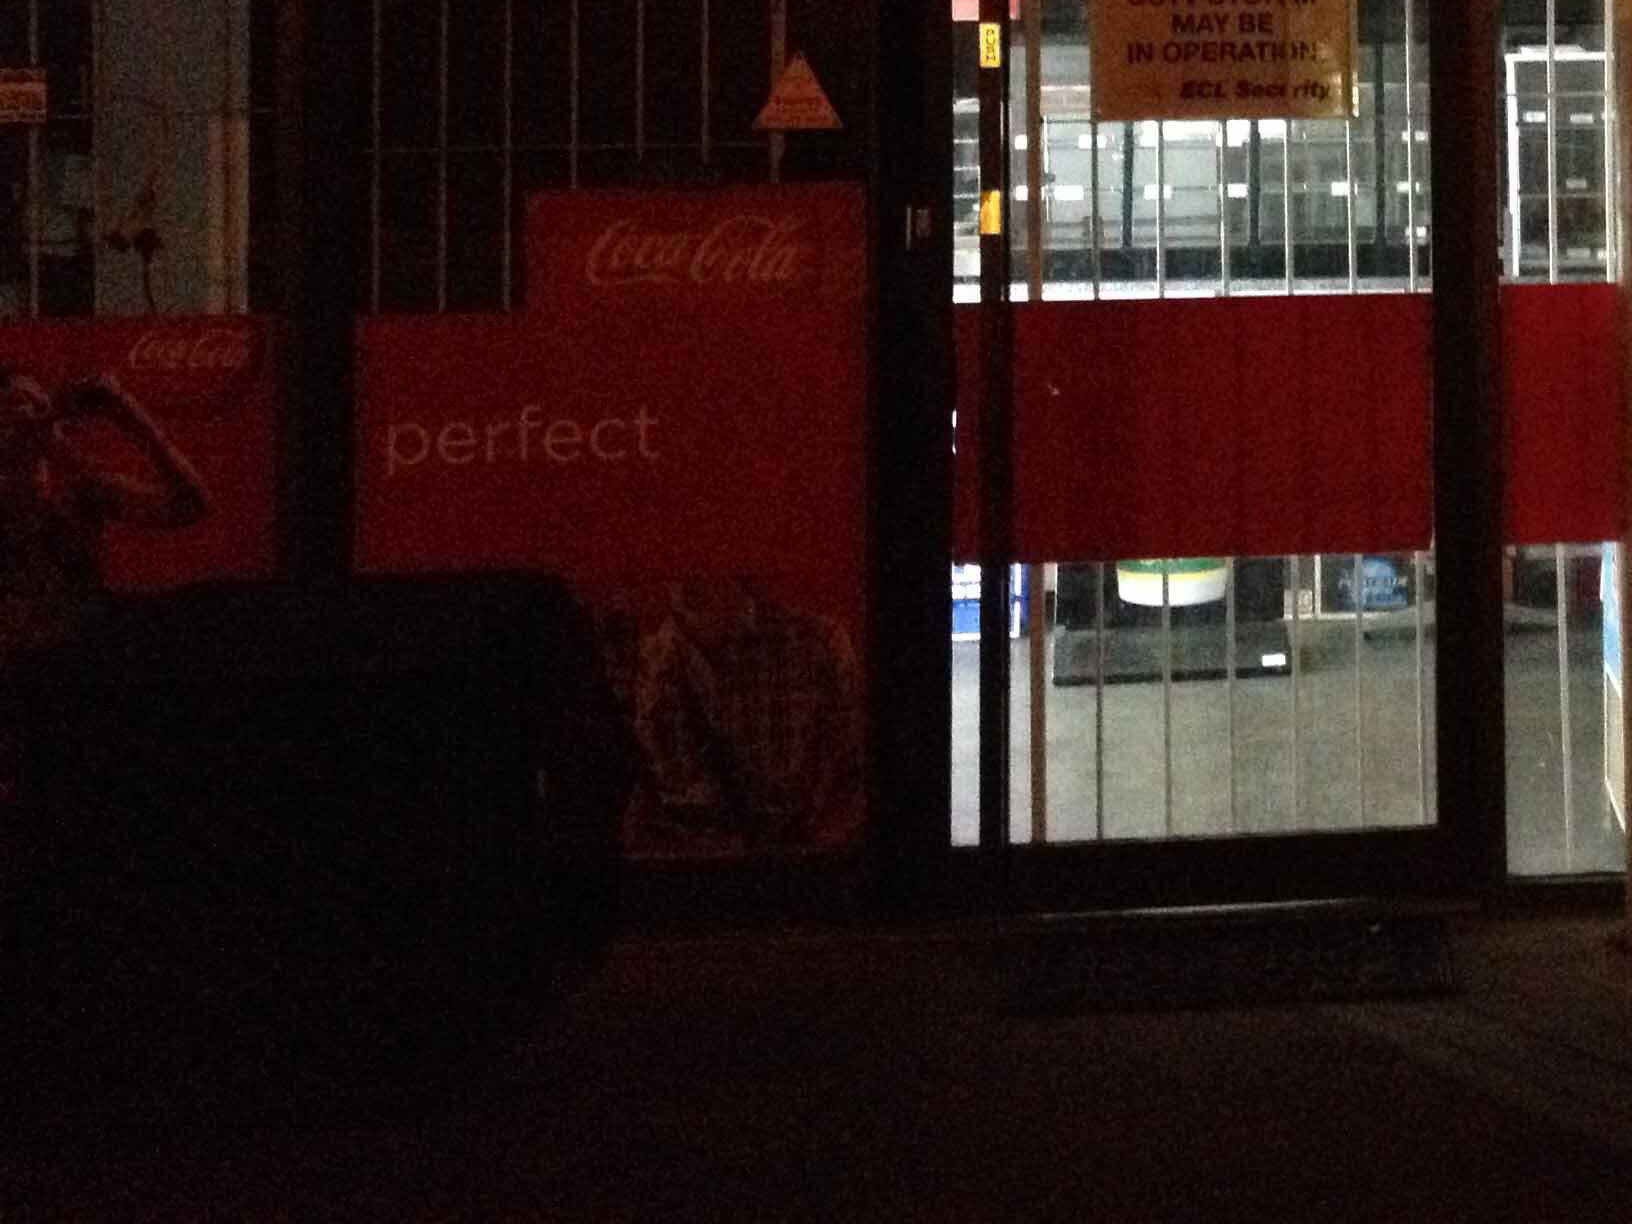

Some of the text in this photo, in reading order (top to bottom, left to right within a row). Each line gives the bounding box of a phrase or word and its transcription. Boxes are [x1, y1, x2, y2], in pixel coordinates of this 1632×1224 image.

[1172, 12, 1274, 33] MAY BE
[1127, 42, 1154, 64] IN
[387, 405, 661, 477] perfect
